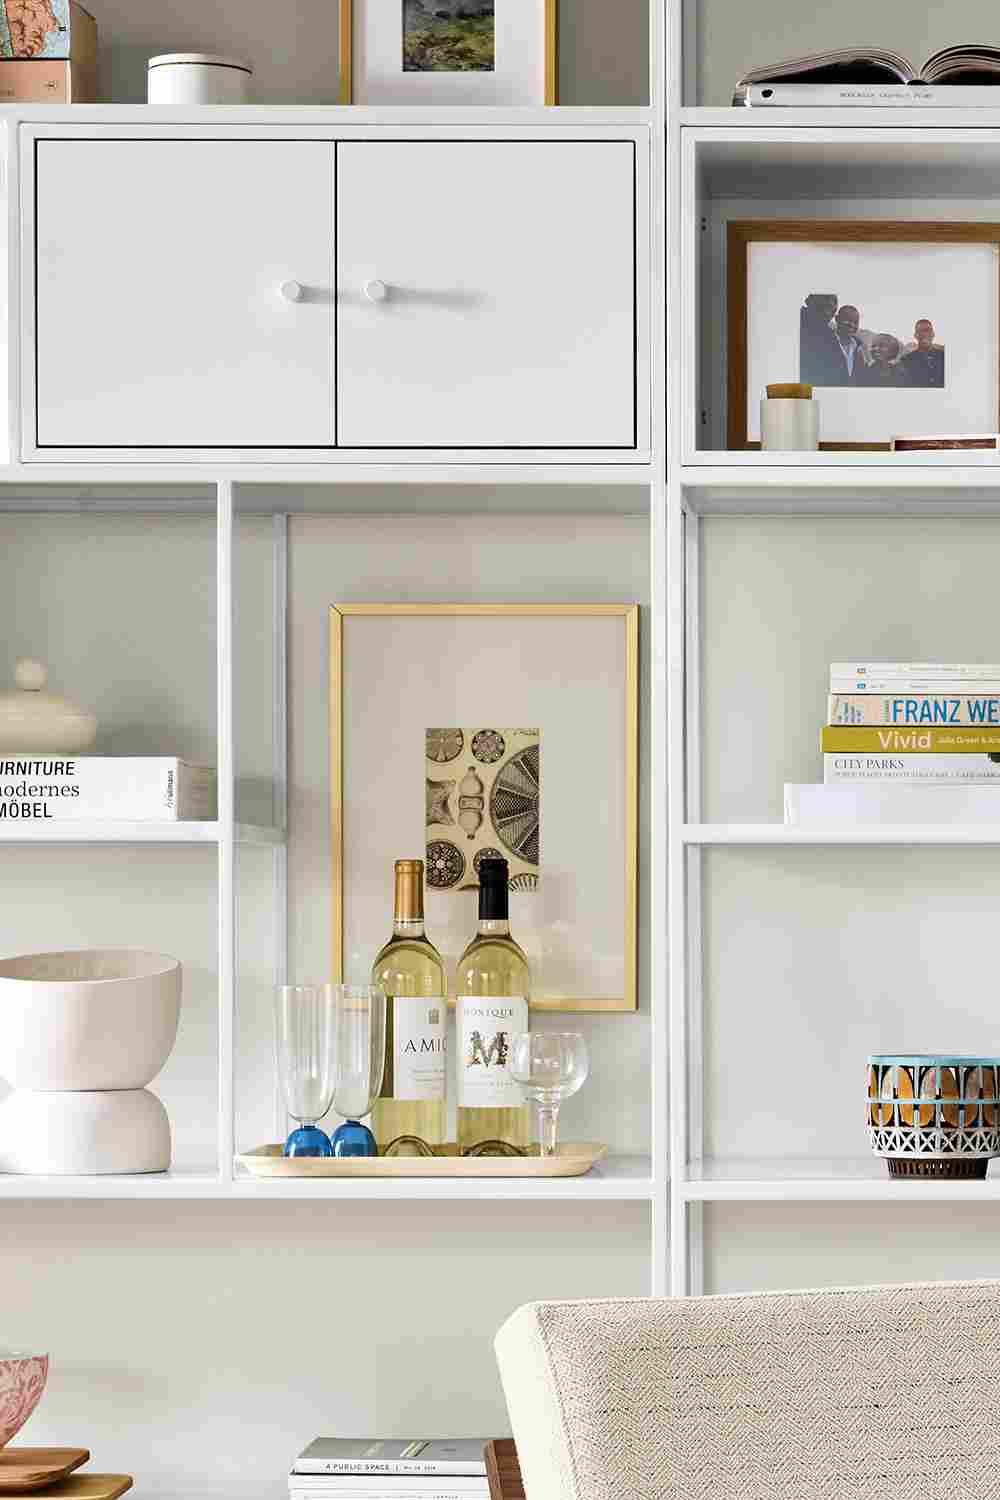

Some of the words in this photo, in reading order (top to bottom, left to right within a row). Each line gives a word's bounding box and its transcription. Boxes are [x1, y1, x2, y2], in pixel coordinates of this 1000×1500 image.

[892, 699, 961, 723] FRANZ
[878, 730, 932, 749] Vivid
[0, 761, 75, 776] RNITURE
[834, 759, 863, 769] CITY
[866, 759, 905, 769] PARKS
[0, 780, 80, 797] odernes
